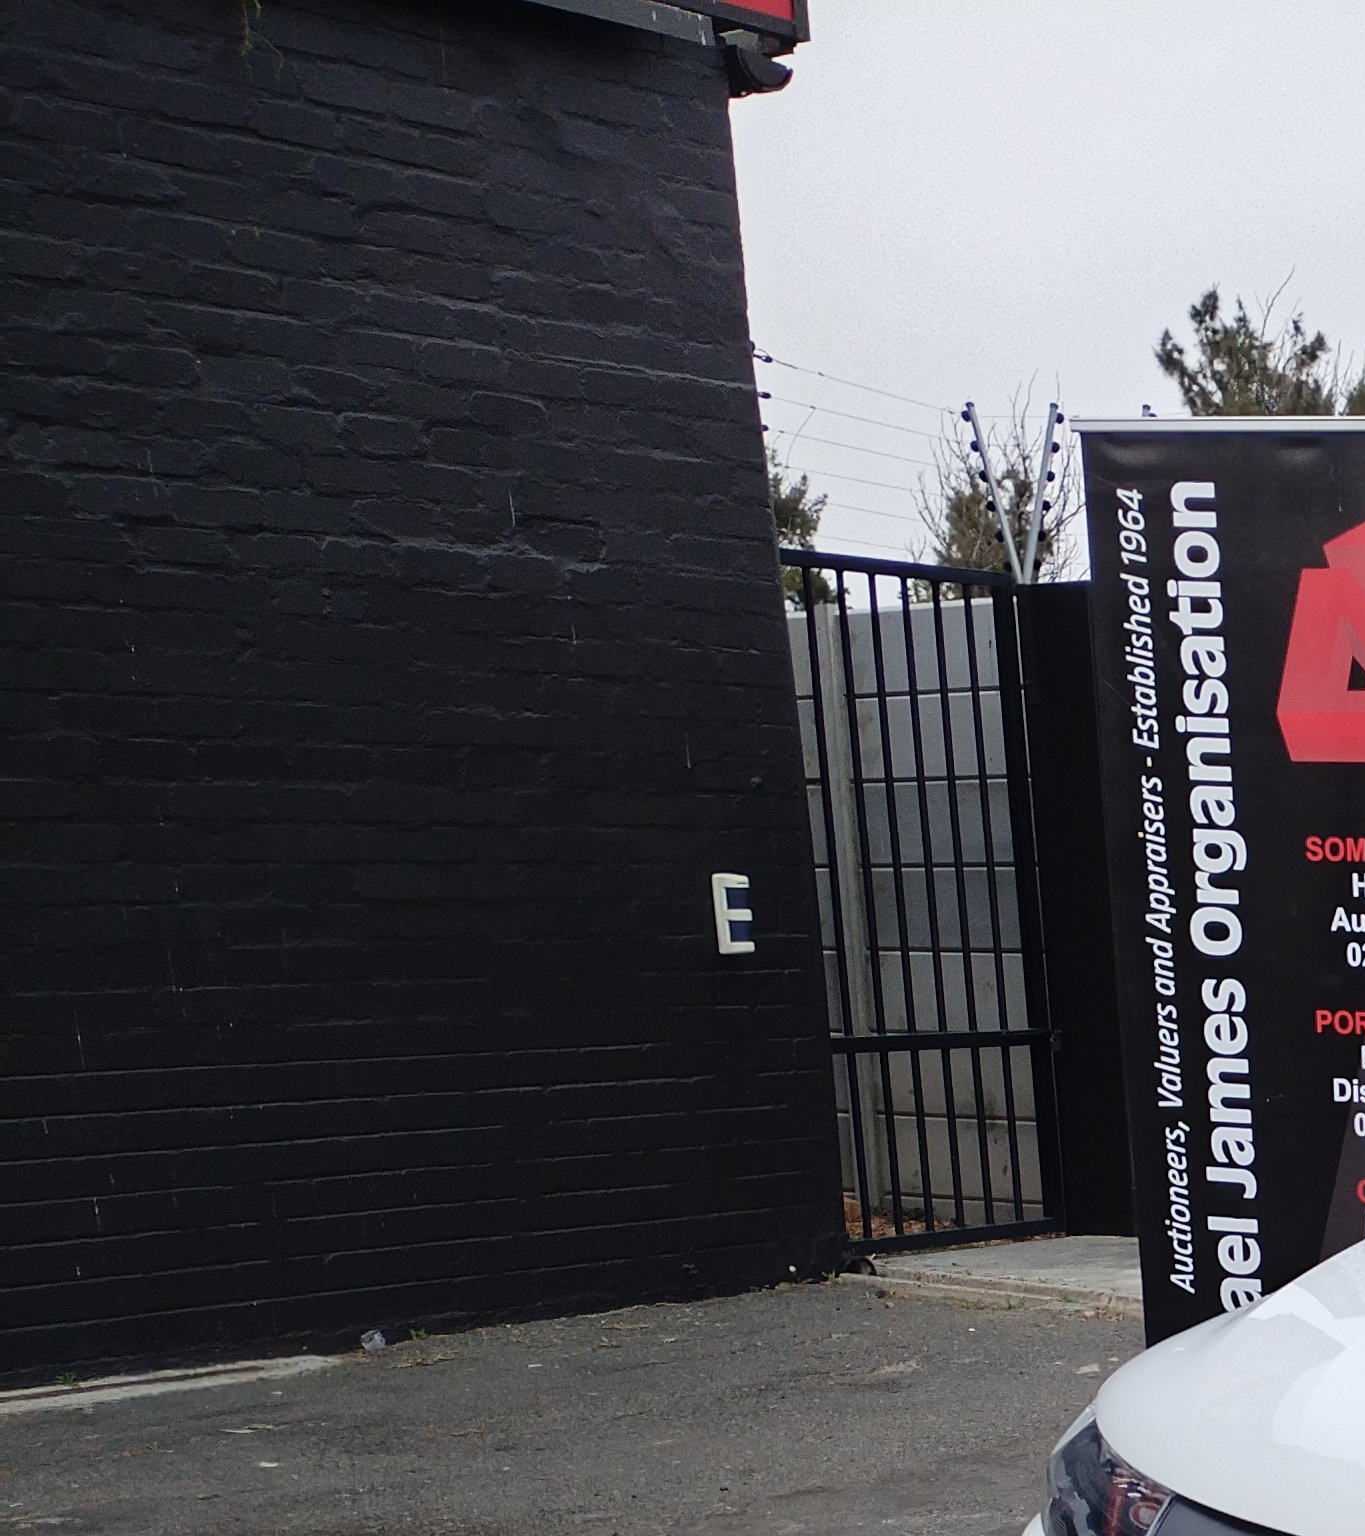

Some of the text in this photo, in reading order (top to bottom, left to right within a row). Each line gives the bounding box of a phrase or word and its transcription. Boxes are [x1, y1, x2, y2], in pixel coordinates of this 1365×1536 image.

[1117, 489, 1147, 564] 1964
[1120, 573, 1159, 749] Established
[1167, 481, 1248, 957] Organisation
[712, 874, 754, 953] E
[1138, 776, 1176, 933] Appraisers
[1146, 937, 1175, 995] and
[1154, 1003, 1183, 1106] Valuers
[1202, 979, 1257, 1198] James
[1166, 1122, 1195, 1293] Auctioneers,
